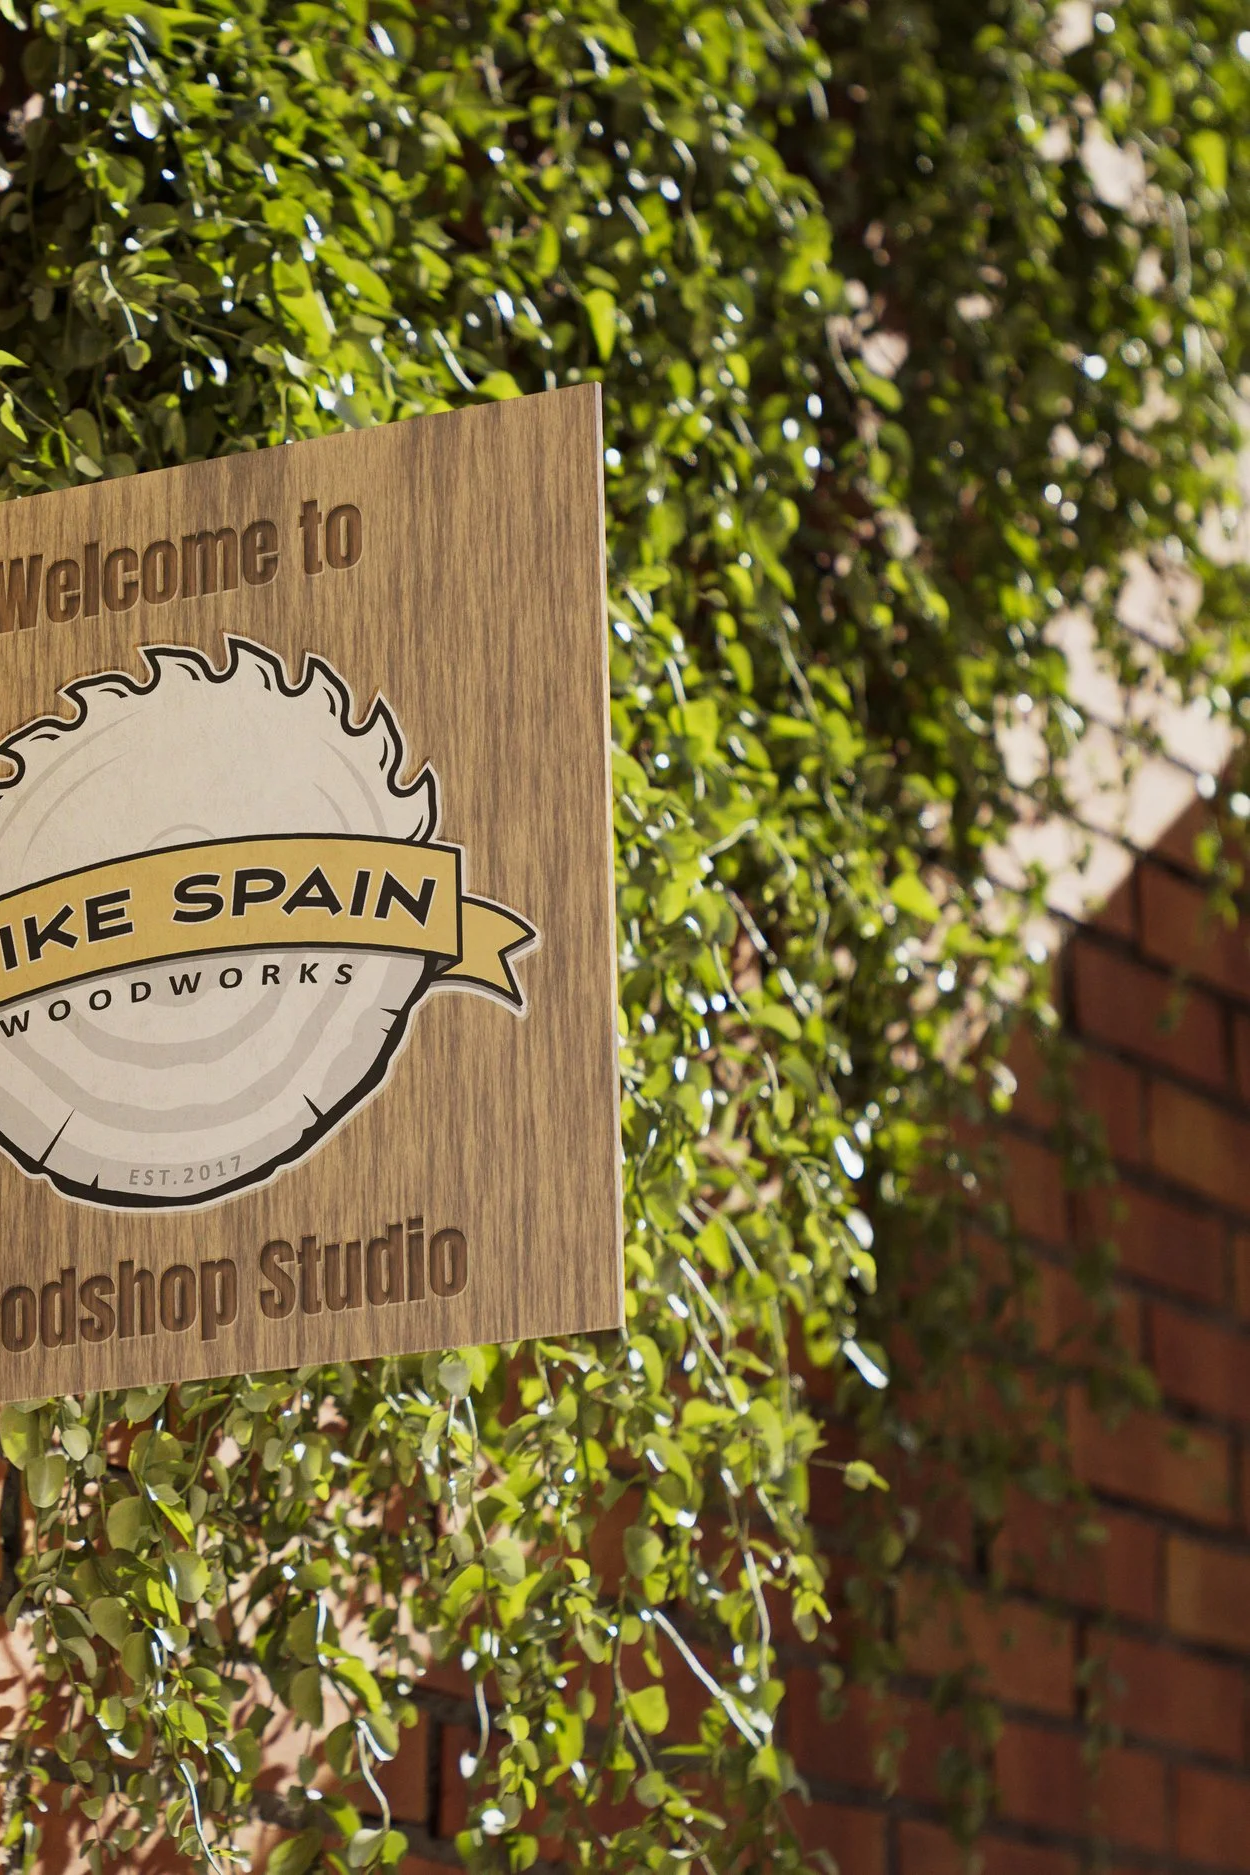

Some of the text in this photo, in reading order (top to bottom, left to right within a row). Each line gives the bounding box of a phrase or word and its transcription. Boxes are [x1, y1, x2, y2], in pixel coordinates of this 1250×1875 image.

[299, 499, 363, 576] to
[172, 866, 437, 927] SPAIN
[259, 1214, 469, 1320] Studio
